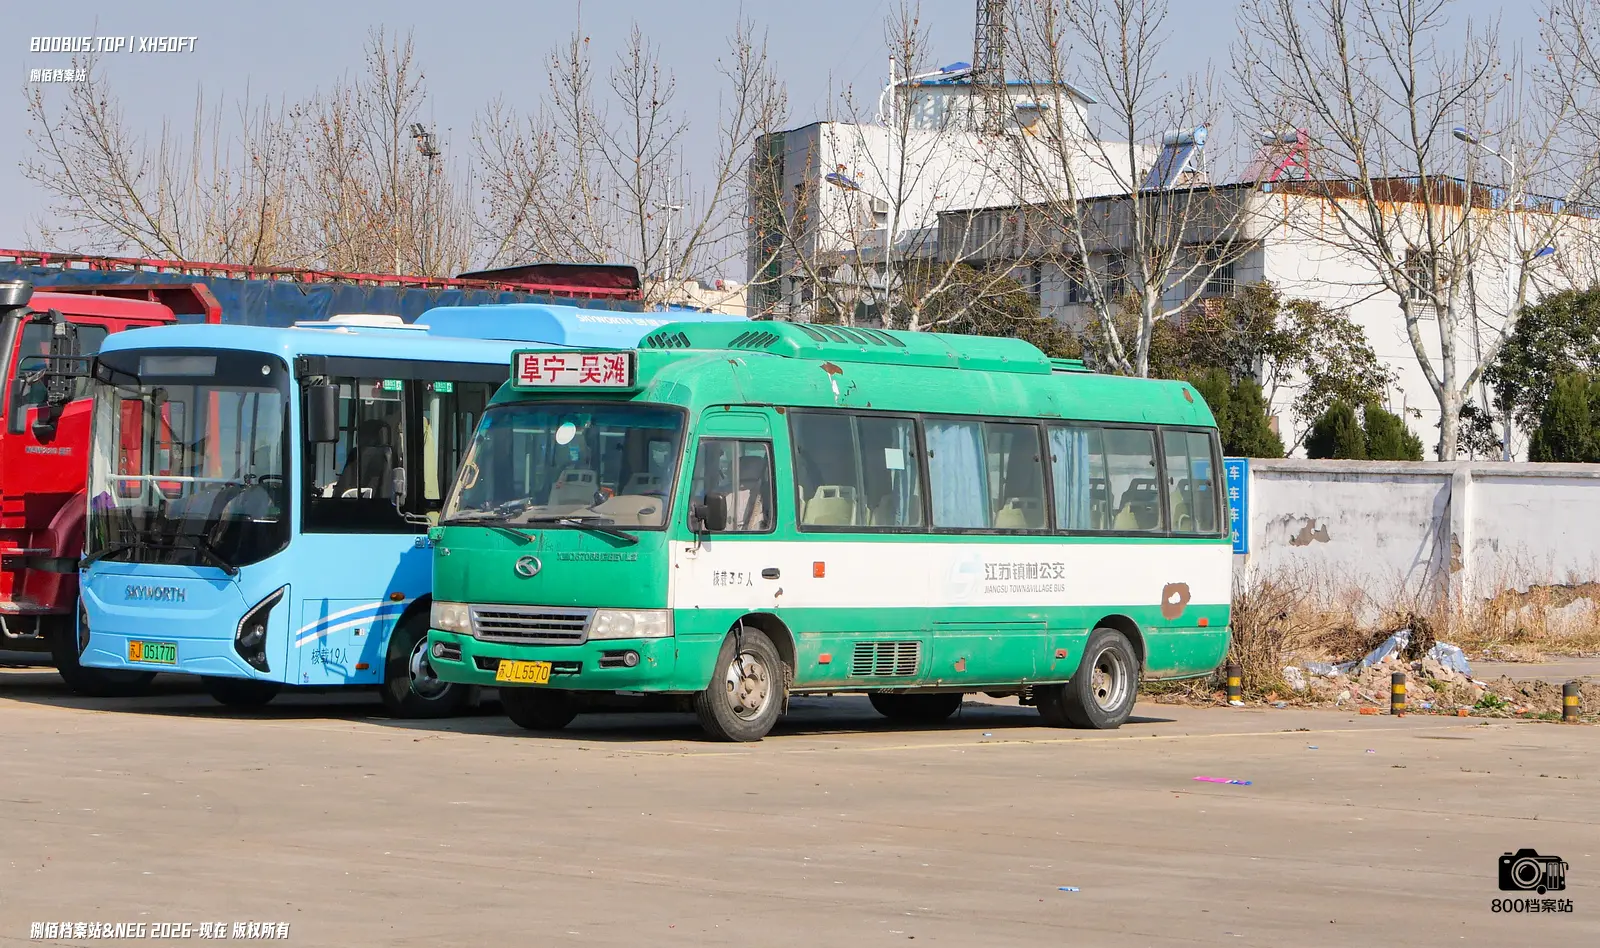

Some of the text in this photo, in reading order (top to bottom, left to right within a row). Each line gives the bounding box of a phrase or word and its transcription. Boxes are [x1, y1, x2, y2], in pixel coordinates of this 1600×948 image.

[984, 561, 1065, 581] 江苏镇村公交
[125, 584, 186, 602] SKYWORTH
[984, 585, 1009, 594] JIANGSU
[1053, 583, 1065, 592] BUS
